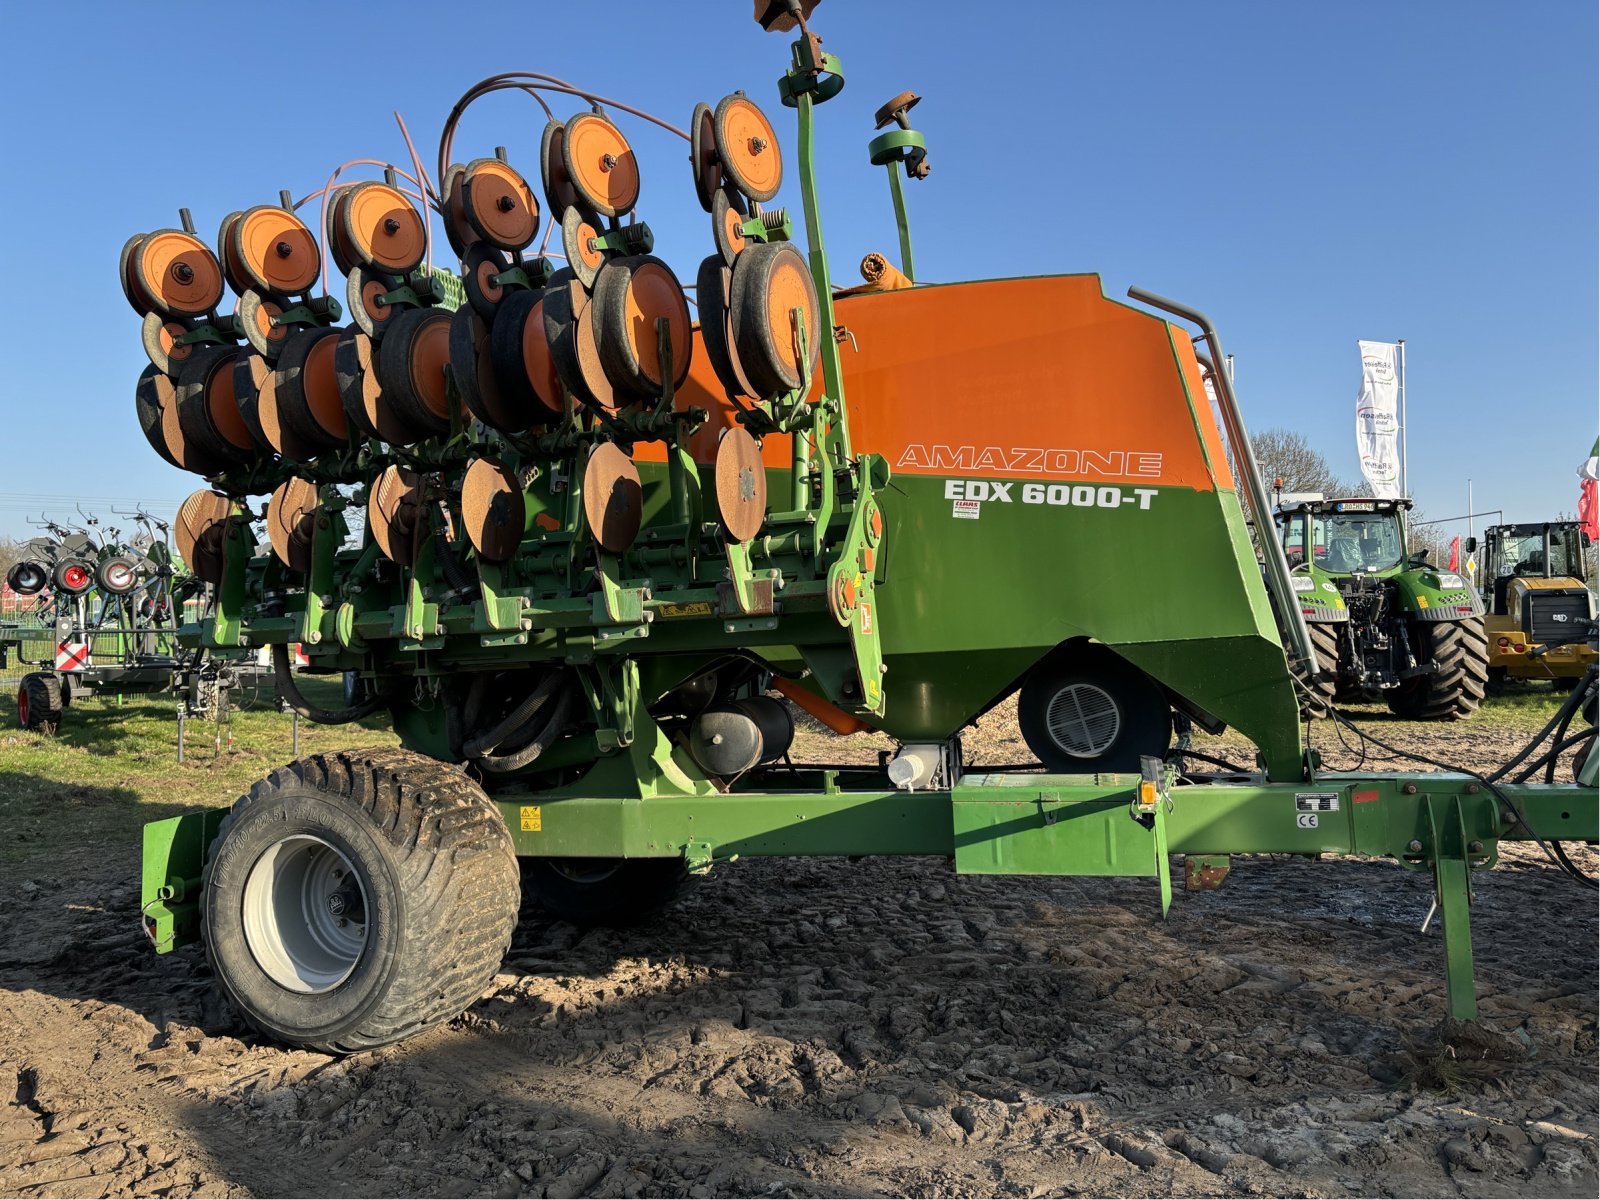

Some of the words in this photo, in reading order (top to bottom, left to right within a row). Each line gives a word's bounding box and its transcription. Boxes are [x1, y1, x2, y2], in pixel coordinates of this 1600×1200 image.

[897, 444, 1162, 477] AMAZONE
[944, 479, 1013, 502] EDX
[1022, 483, 1158, 510] 6000-T
[1502, 566, 1512, 574] 20
[1299, 815, 1316, 827] CE
